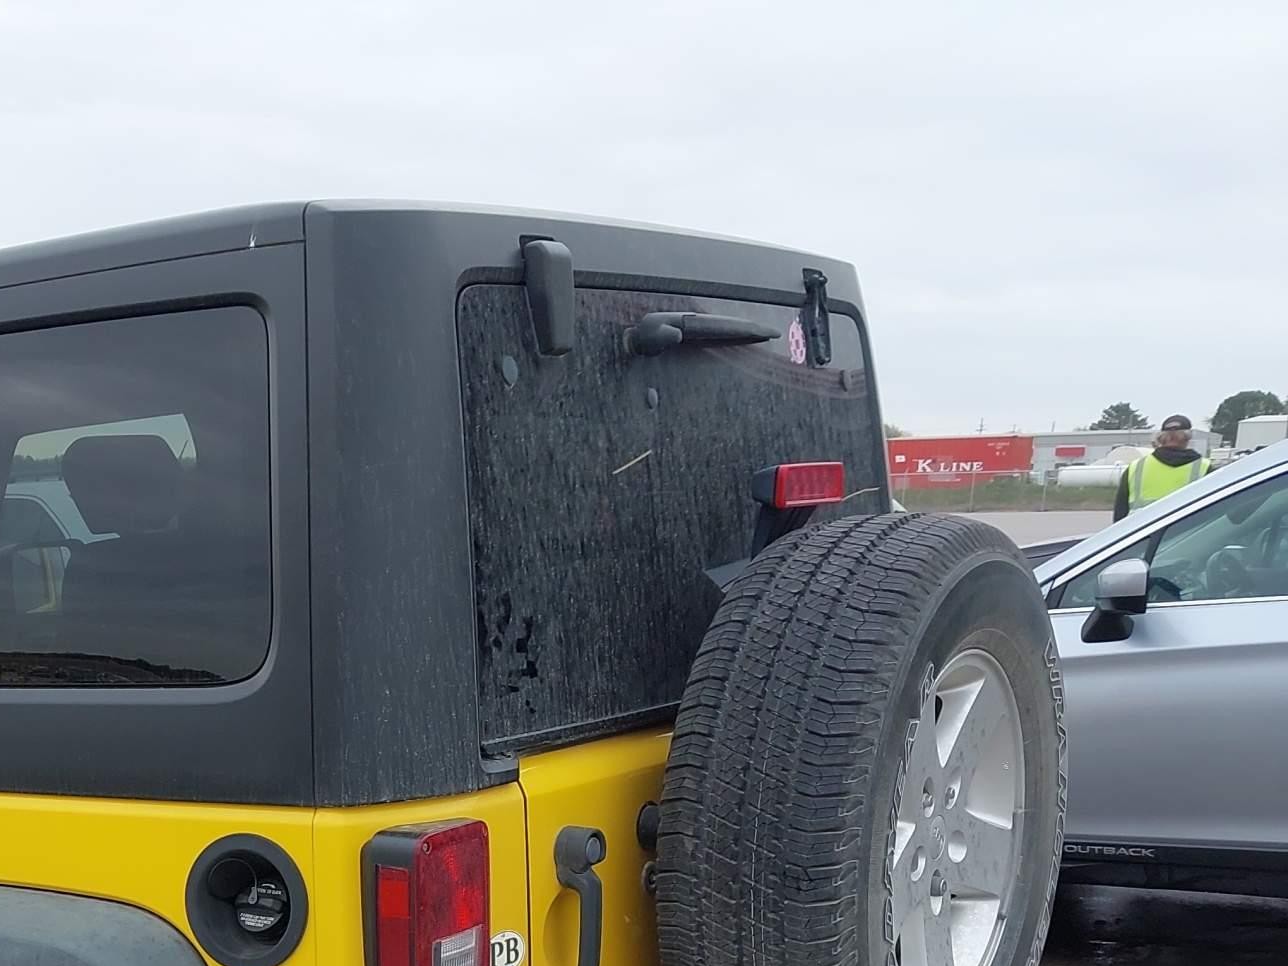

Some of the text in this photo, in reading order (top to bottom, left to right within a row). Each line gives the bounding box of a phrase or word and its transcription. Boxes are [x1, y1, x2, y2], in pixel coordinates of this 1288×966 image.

[912, 458, 984, 473] K LINE
[1063, 844, 1156, 858] OUTBACK
